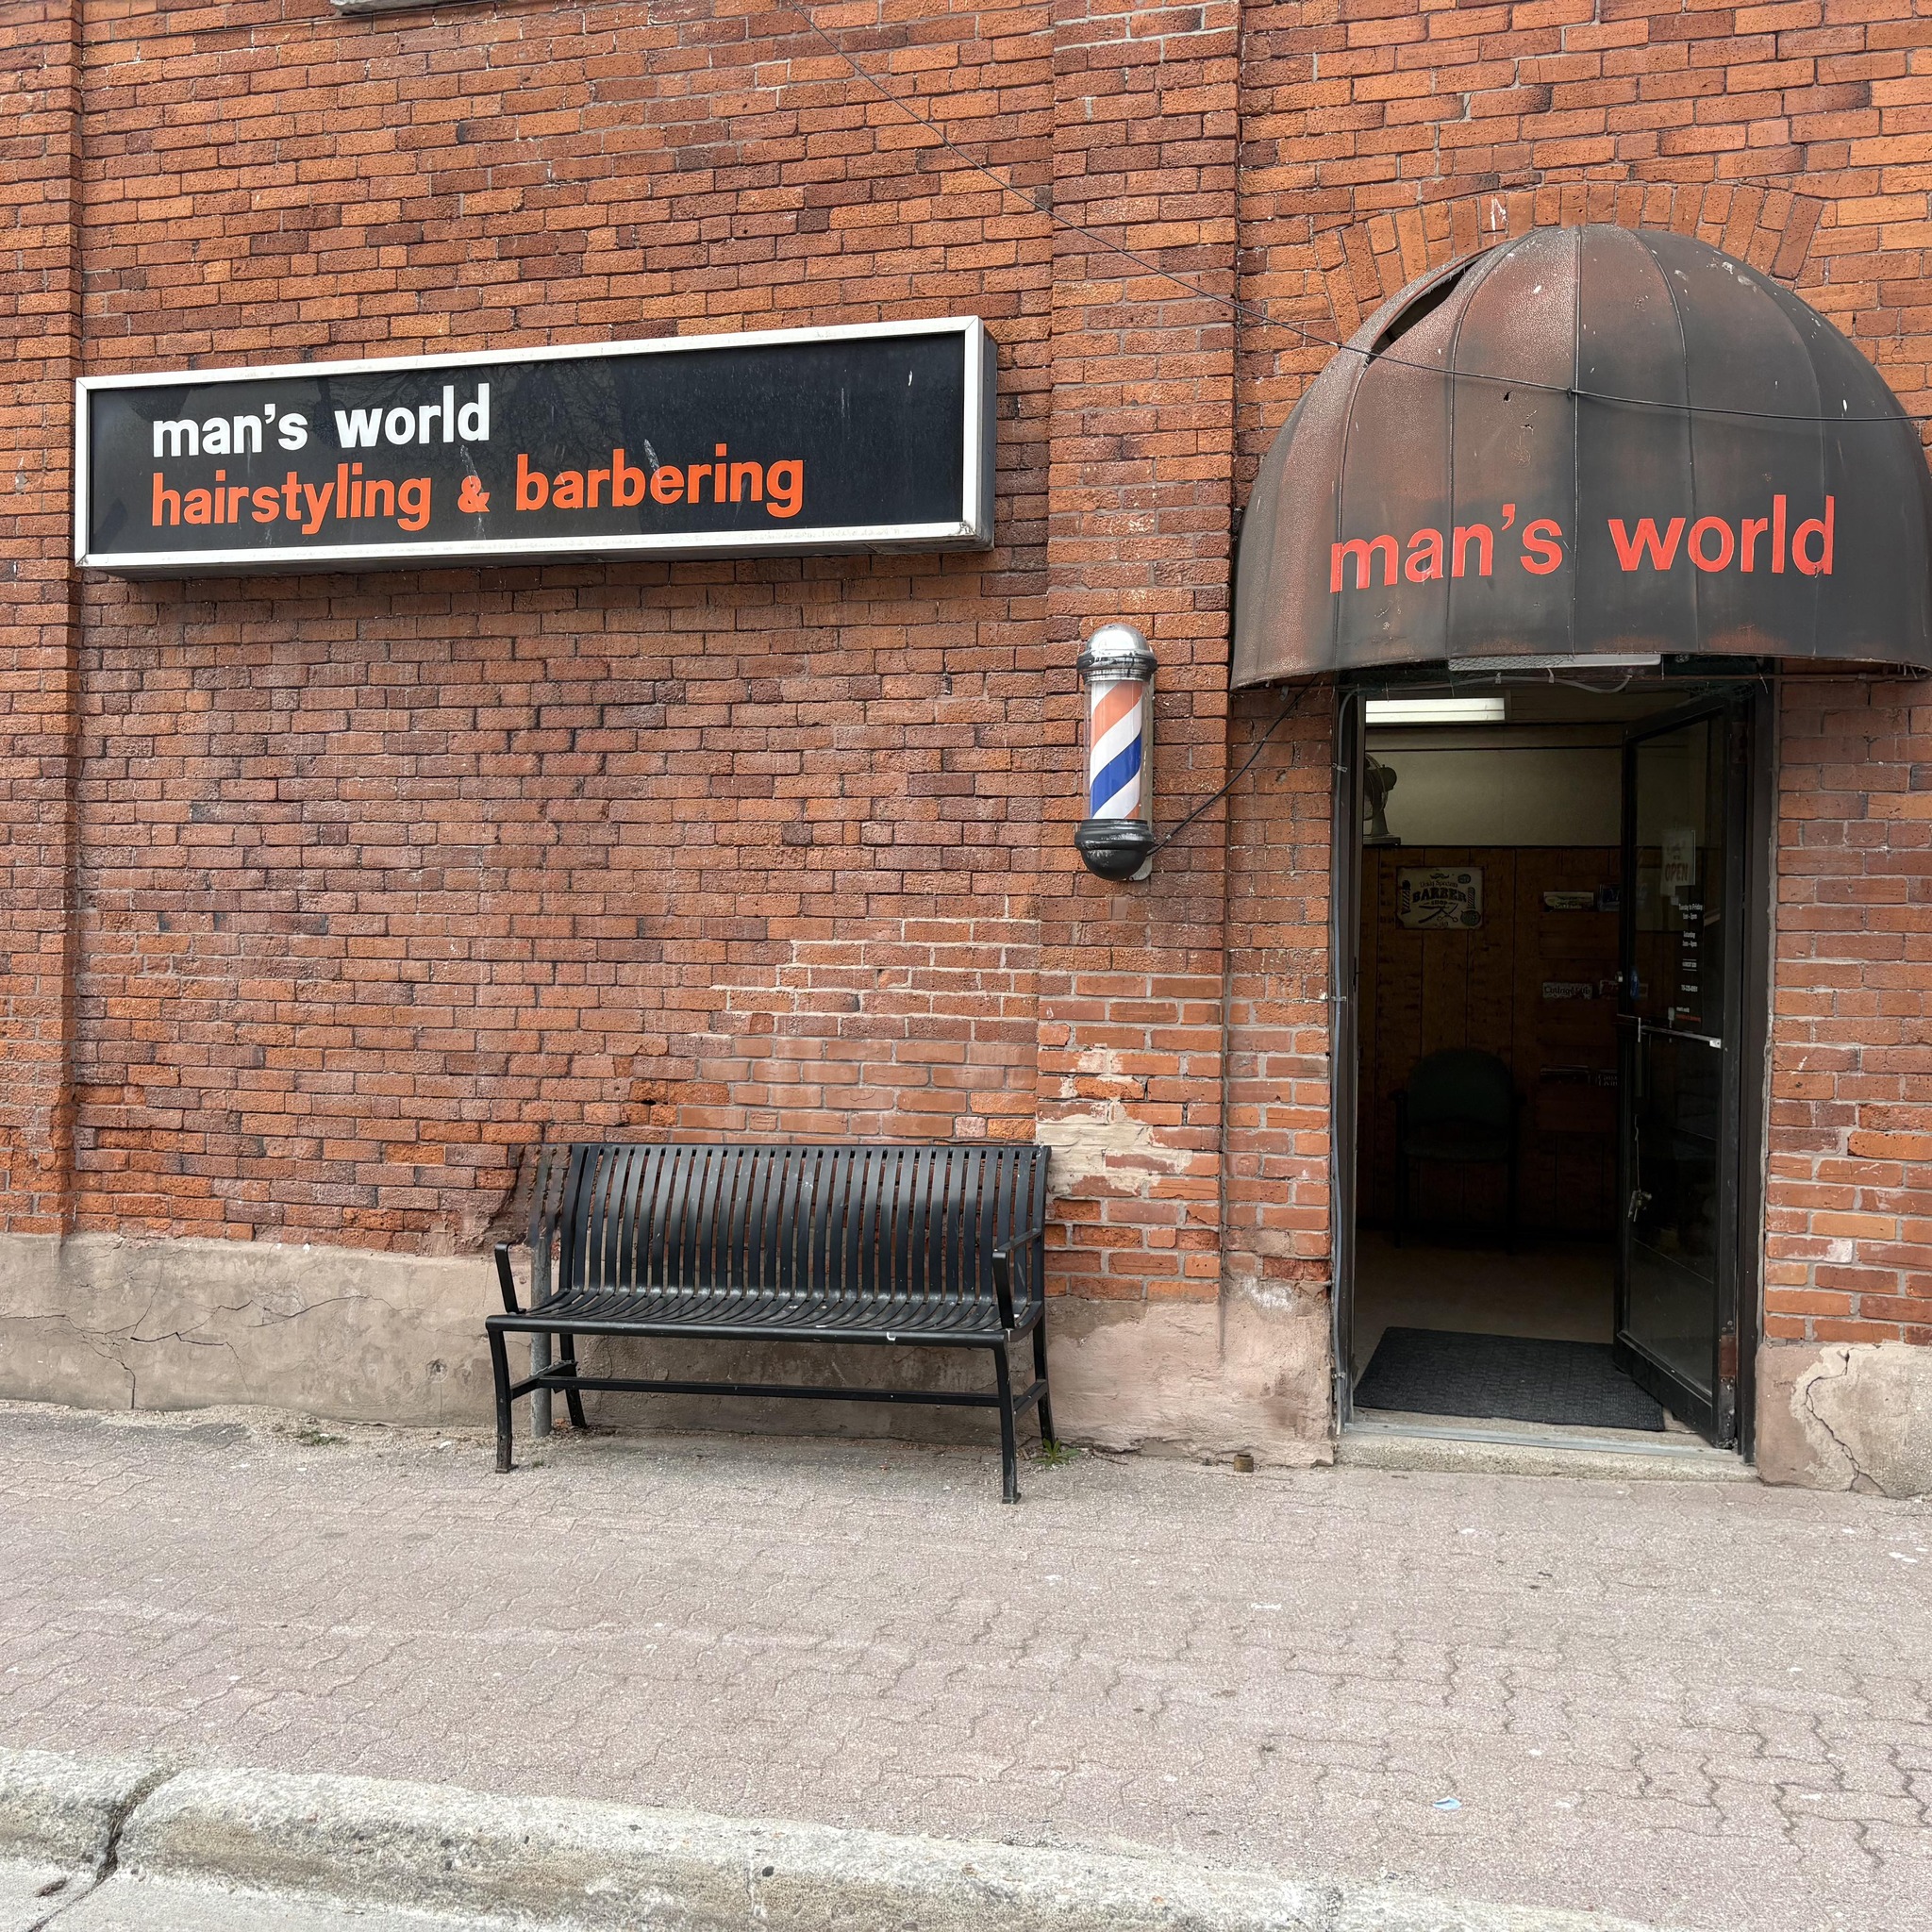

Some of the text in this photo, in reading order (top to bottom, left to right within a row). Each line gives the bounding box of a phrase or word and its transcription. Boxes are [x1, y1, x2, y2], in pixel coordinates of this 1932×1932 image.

[153, 382, 491, 458] man's world
[152, 442, 805, 536] hairstyling & barbering
[1329, 494, 1836, 594] man's world
[1412, 887, 1467, 903] BARBER
[1664, 862, 1690, 882] OPEN
